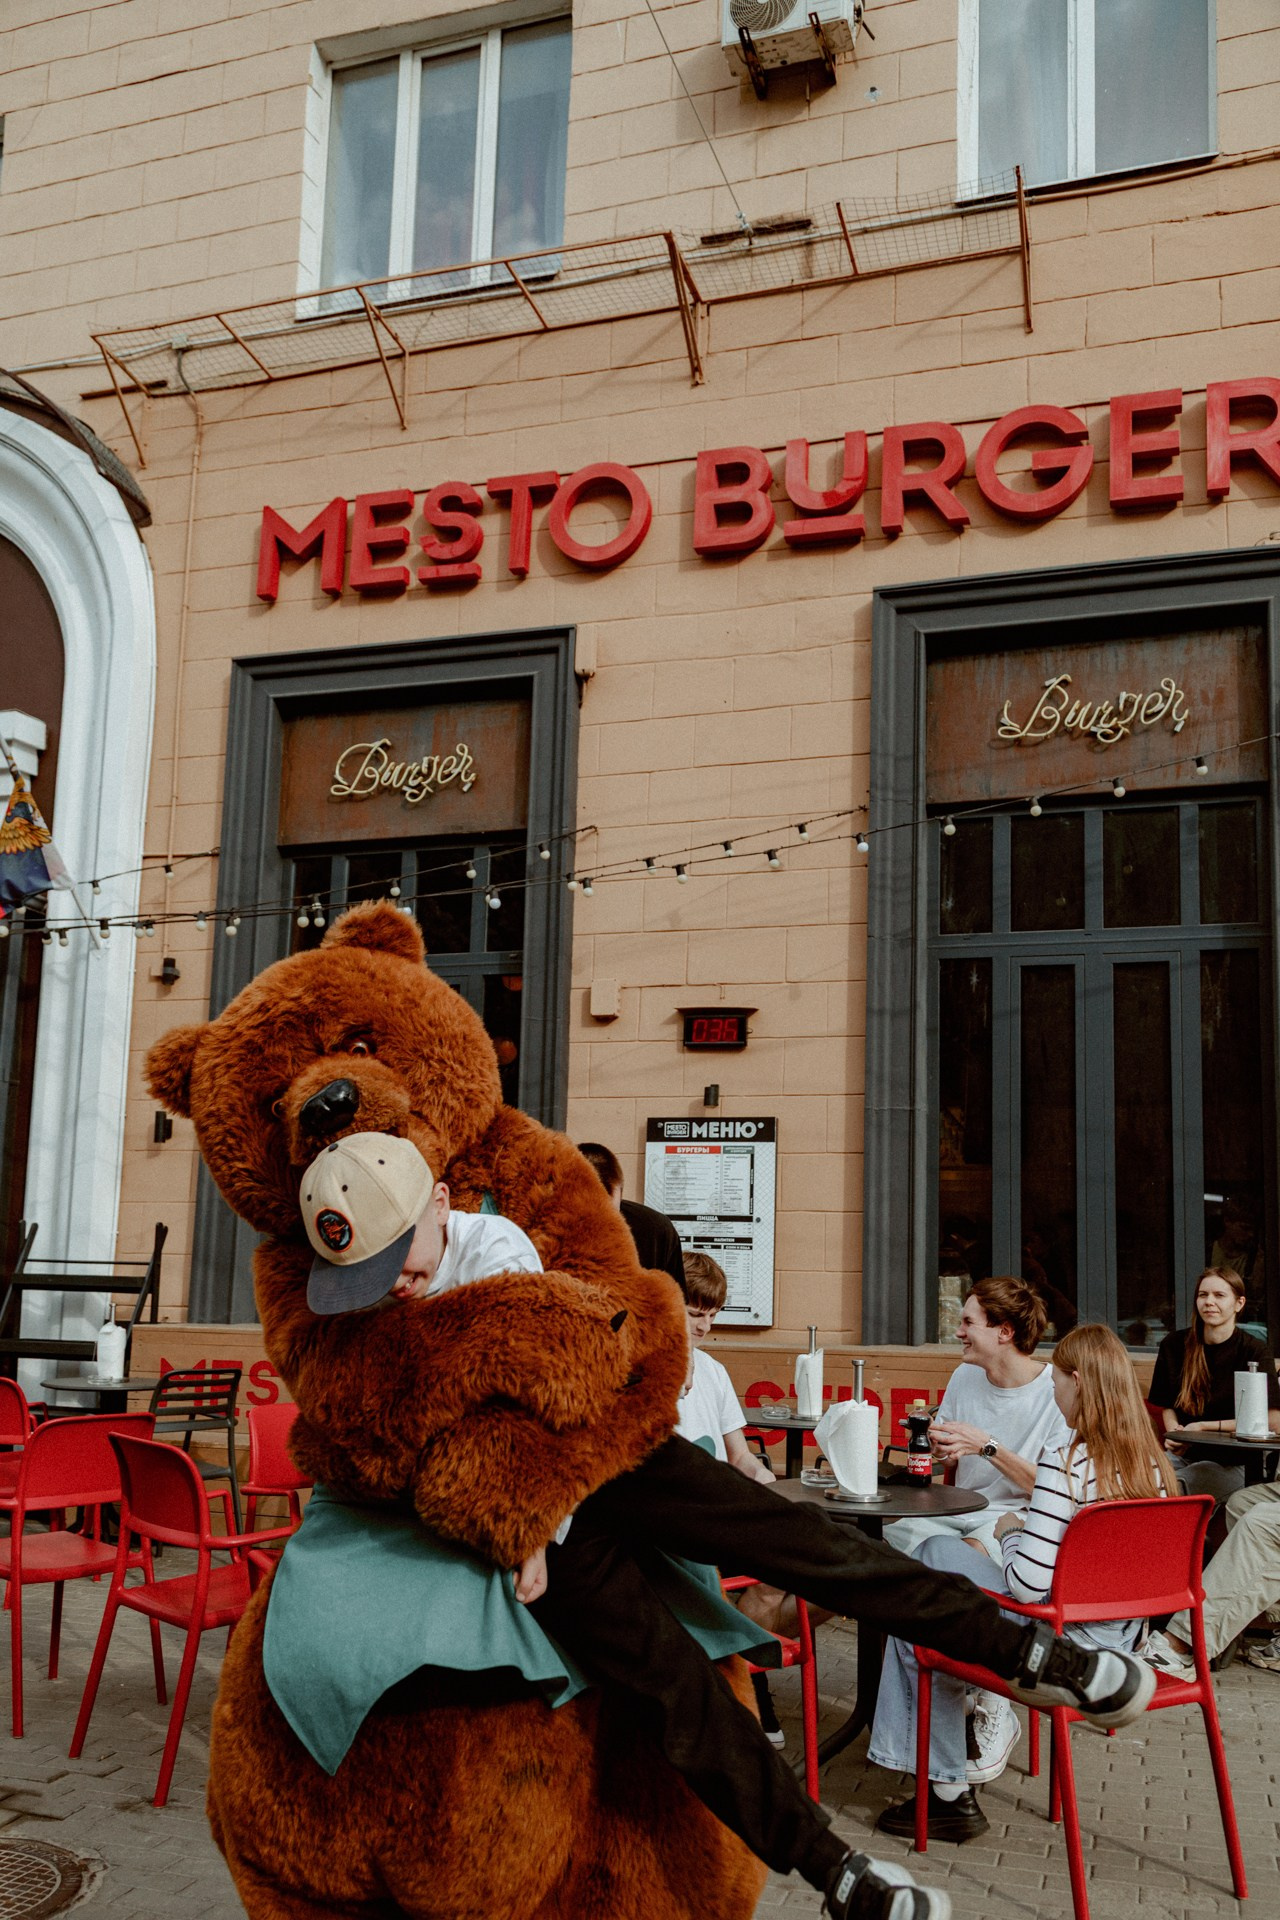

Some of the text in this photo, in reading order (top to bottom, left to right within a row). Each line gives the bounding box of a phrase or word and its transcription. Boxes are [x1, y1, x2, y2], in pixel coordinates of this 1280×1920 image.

[256, 376, 1280, 601] MESTO BURGER
[998, 673, 1189, 743] Burger
[330, 738, 477, 803] Burger
[691, 1121, 757, 1139] МЕНЮ
